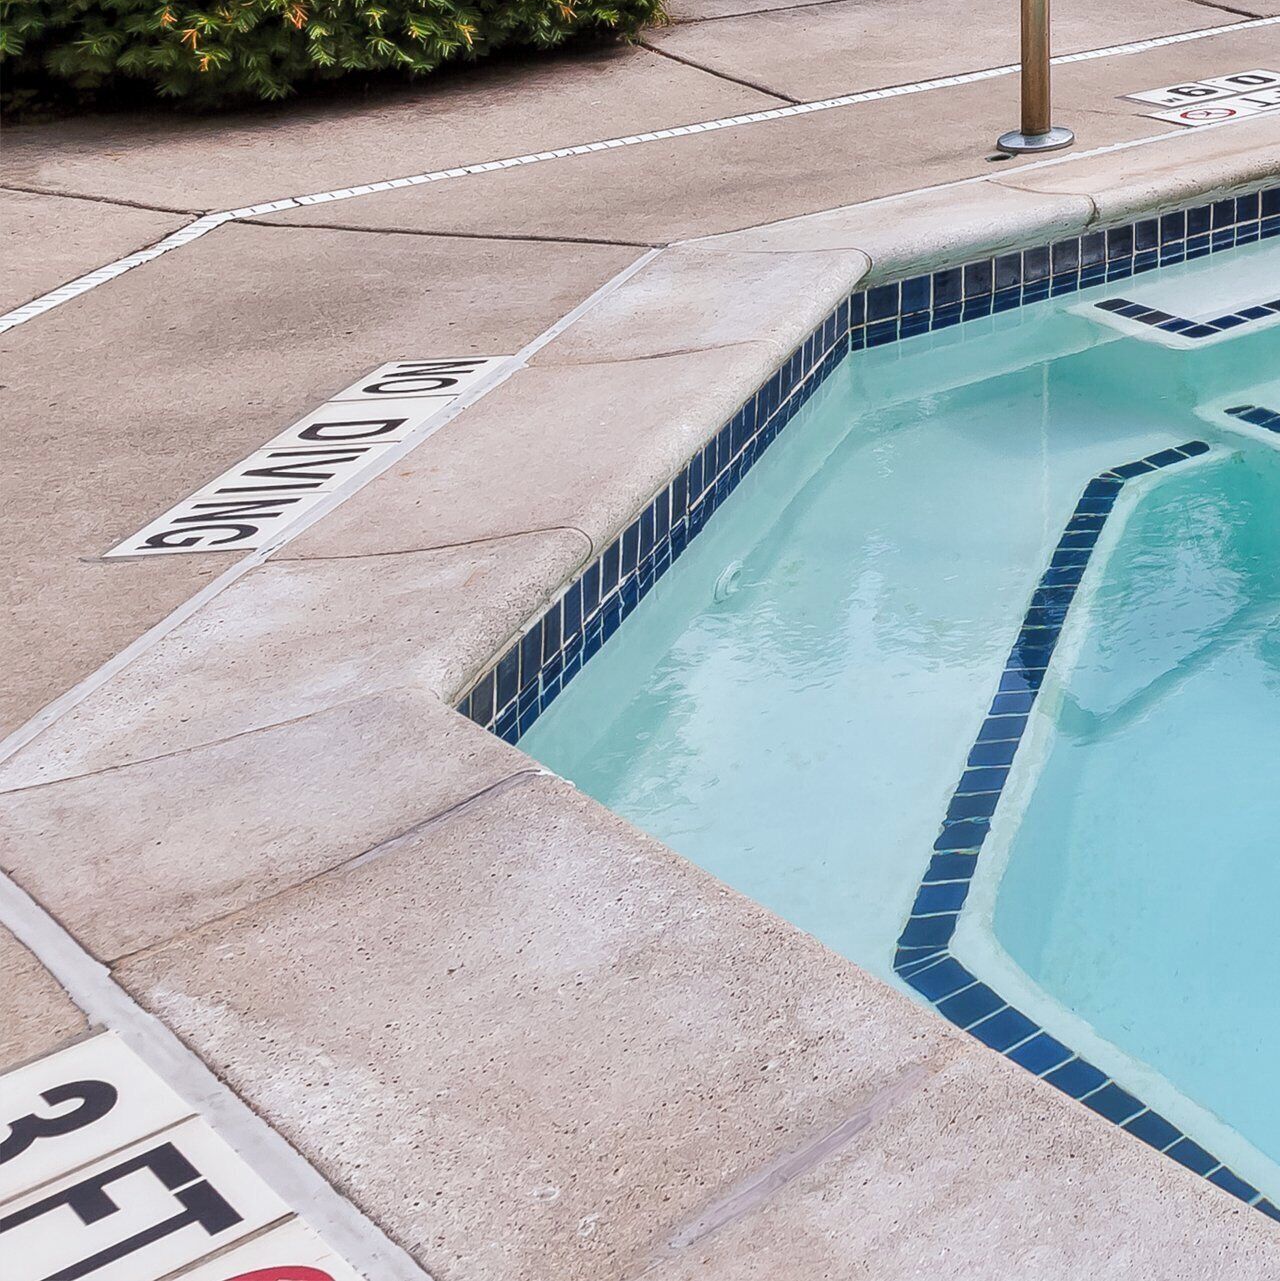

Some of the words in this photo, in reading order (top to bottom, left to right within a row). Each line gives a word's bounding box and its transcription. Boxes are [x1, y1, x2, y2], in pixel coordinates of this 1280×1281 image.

[362, 359, 489, 395] NO
[136, 417, 410, 551] DIVING
[0, 1141, 245, 1281] FT
